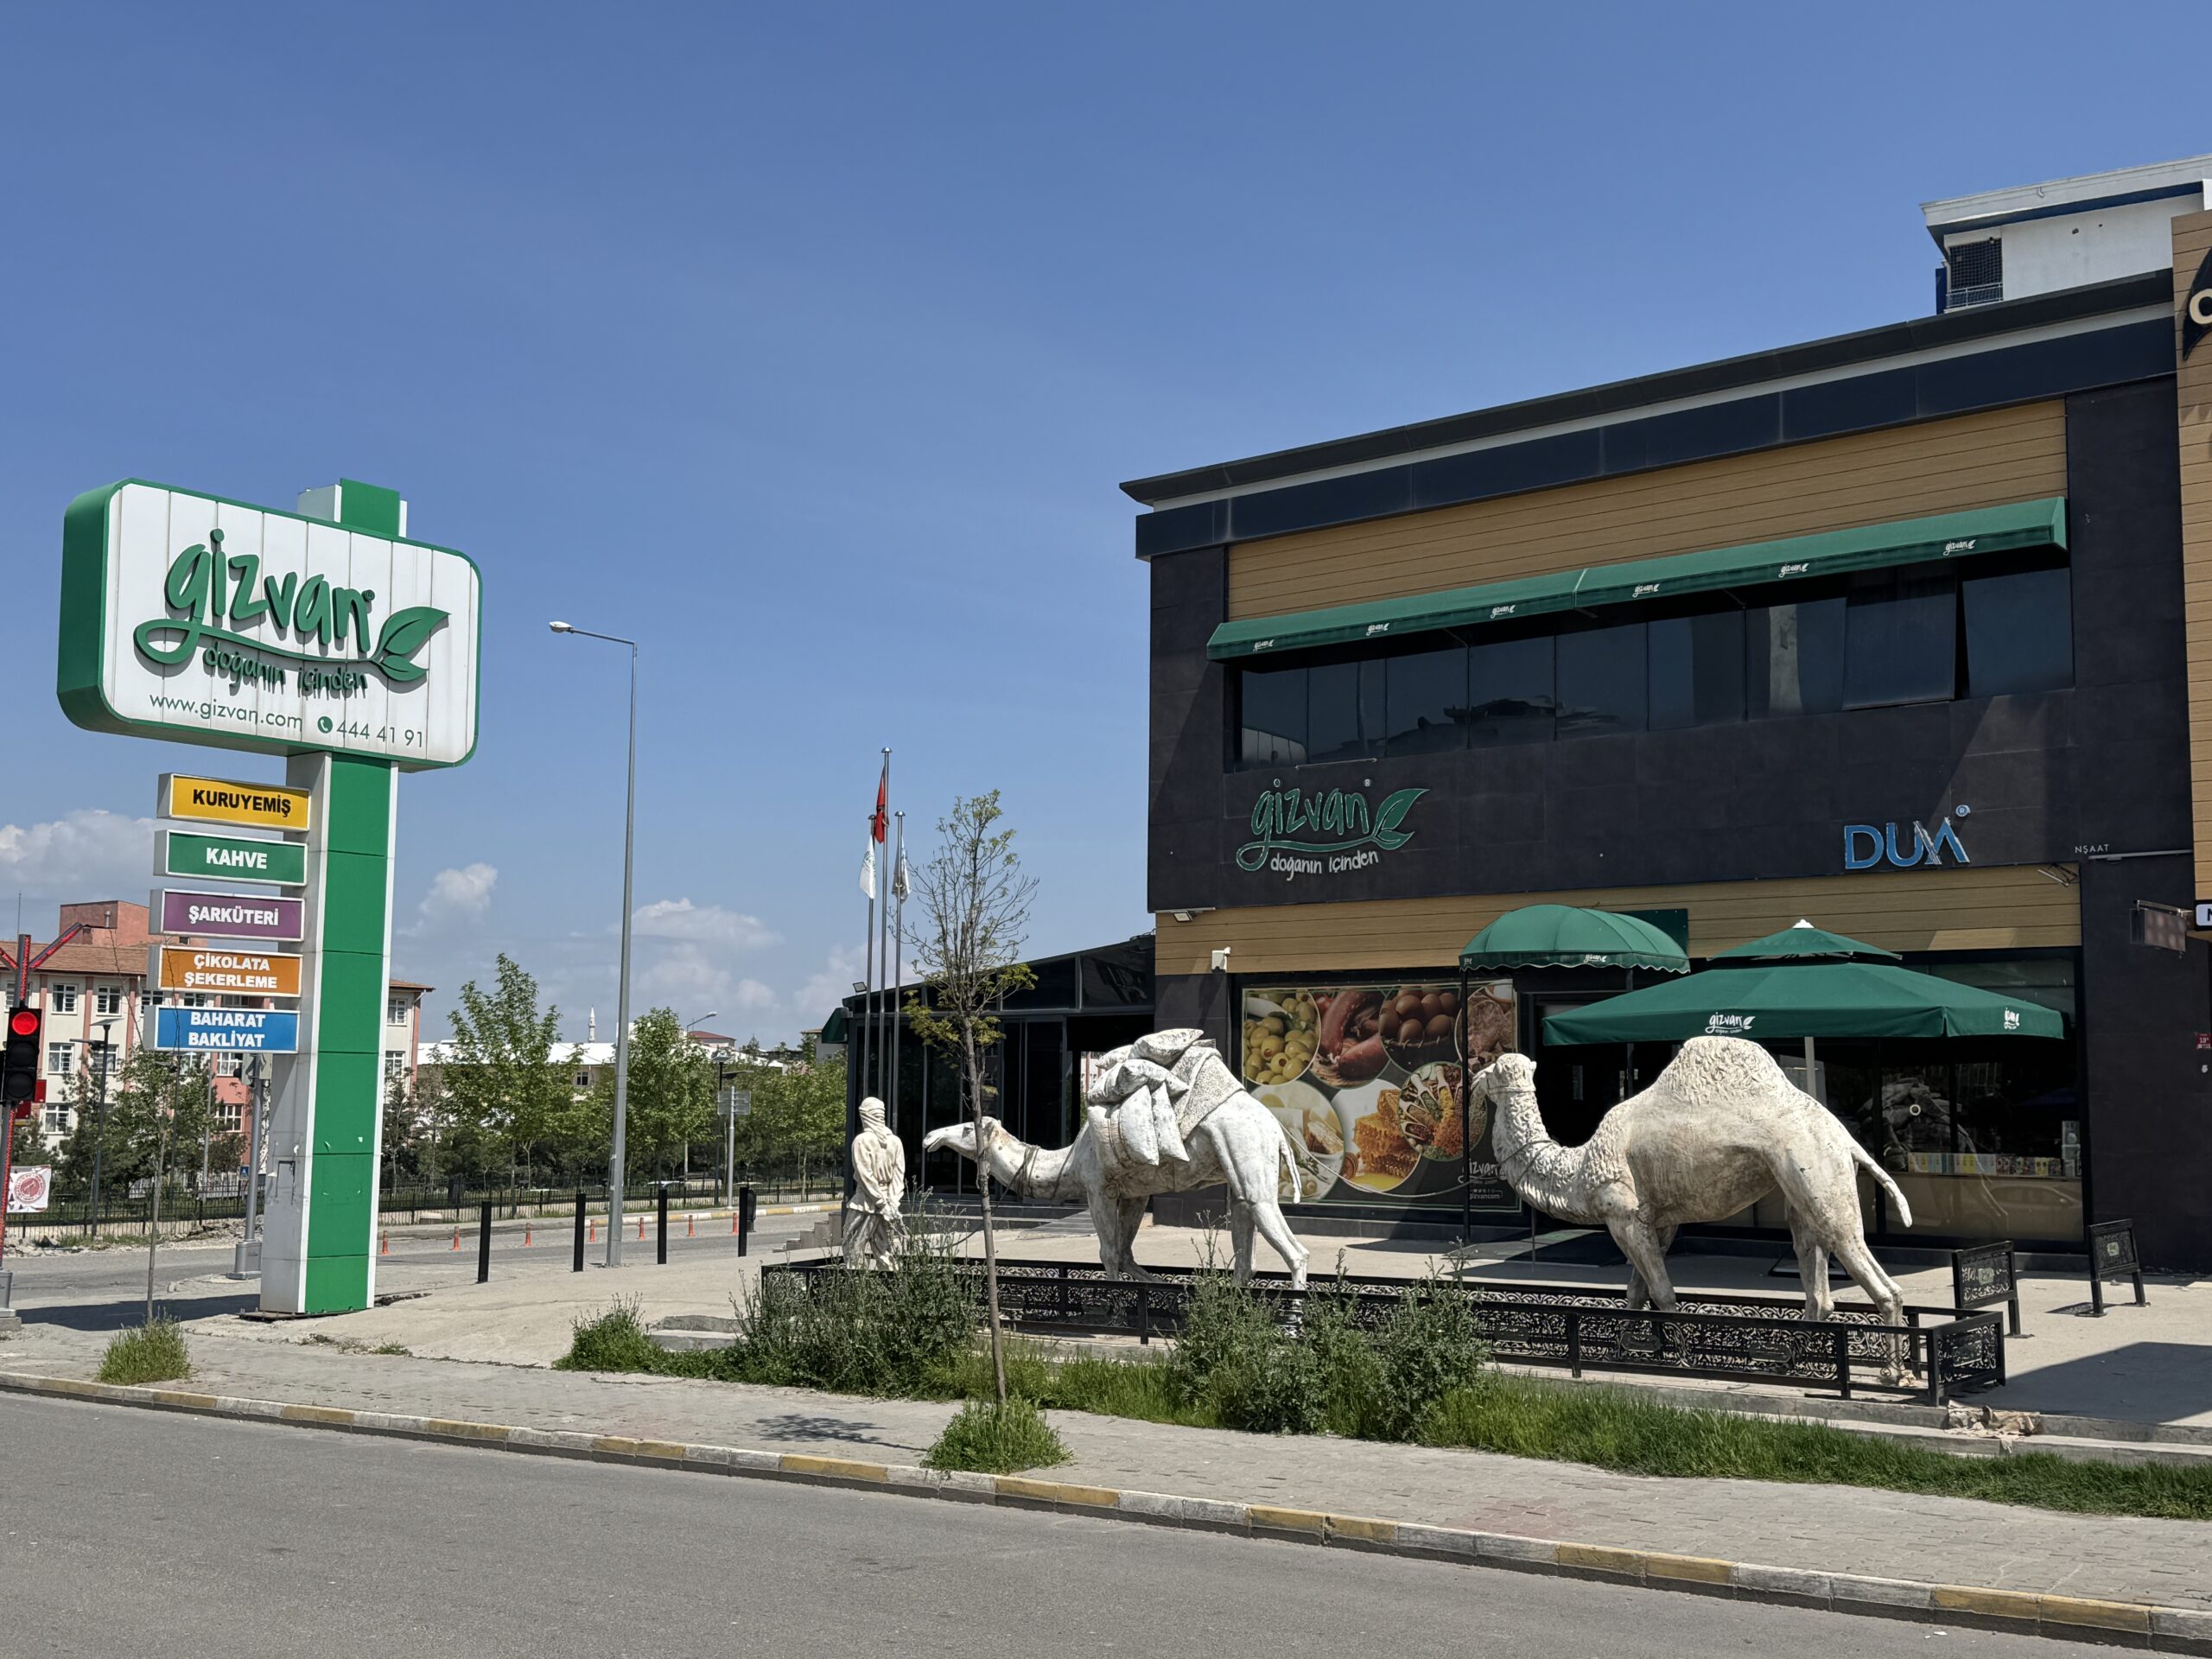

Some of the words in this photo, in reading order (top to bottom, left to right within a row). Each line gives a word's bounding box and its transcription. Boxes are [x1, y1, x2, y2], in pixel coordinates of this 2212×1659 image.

[134, 528, 372, 664] gizvan
[149, 694, 302, 732] www.gizvan.com
[336, 720, 370, 740] 444
[376, 725, 396, 744] 41
[404, 729, 423, 748] 91
[193, 789, 291, 817] KURUYEMİŞ
[1236, 779, 1370, 872] gizvan
[206, 847, 268, 869] KAHVE
[1270, 853, 1322, 881] doğanın
[188, 906, 279, 926] ŞARKÜTERİ
[194, 952, 270, 972] ÇİKOLATA
[184, 971, 277, 988] ŞEKERLEME
[190, 1011, 266, 1027] BAHARAT
[1705, 1012, 1743, 1033] gizvan
[188, 1030, 265, 1047] BAKLİYAT
